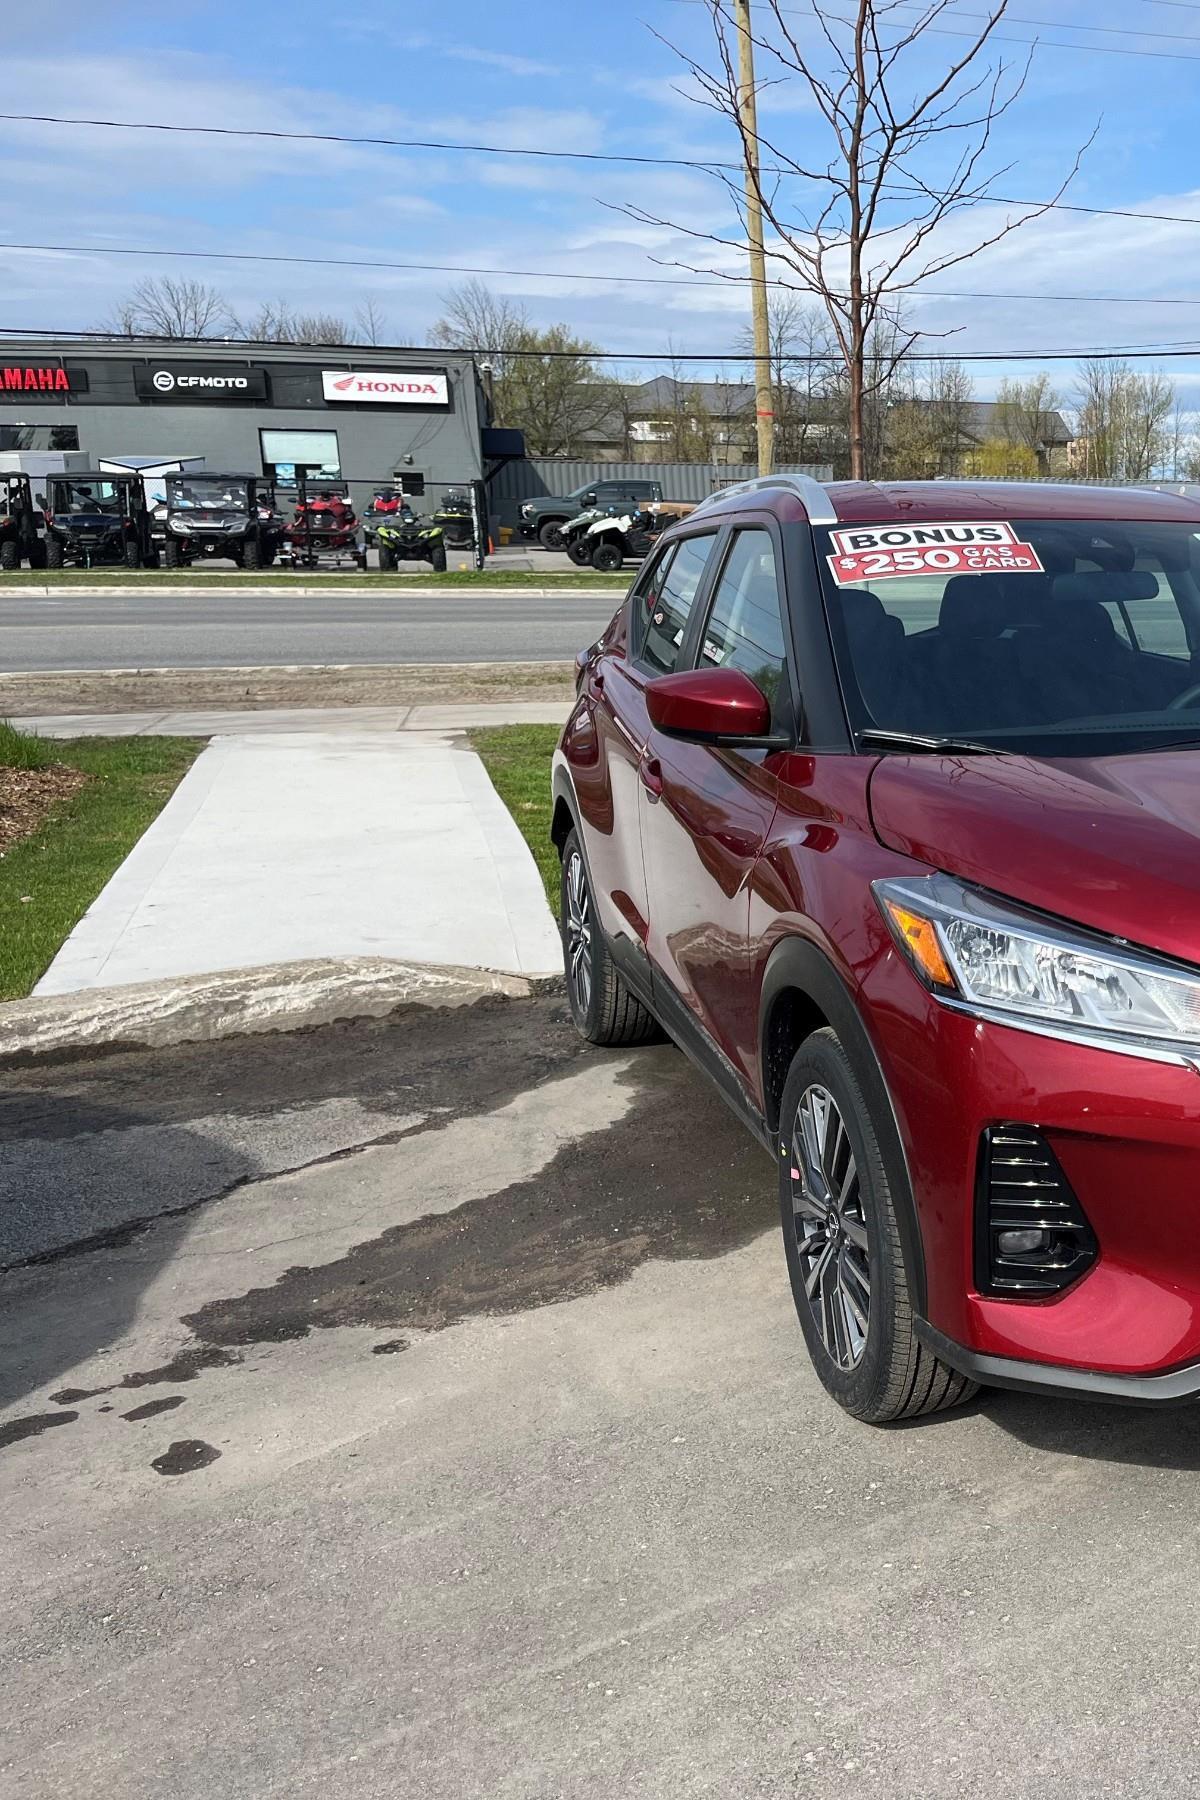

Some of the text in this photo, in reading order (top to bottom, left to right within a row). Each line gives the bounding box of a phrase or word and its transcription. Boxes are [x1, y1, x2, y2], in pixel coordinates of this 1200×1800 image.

[177, 376, 248, 388] CFMOTO
[357, 382, 438, 394] HONDA
[848, 527, 1002, 549] BONUS
[962, 547, 1012, 557] GAS
[839, 549, 960, 575] $250
[967, 557, 1032, 568] CARD
